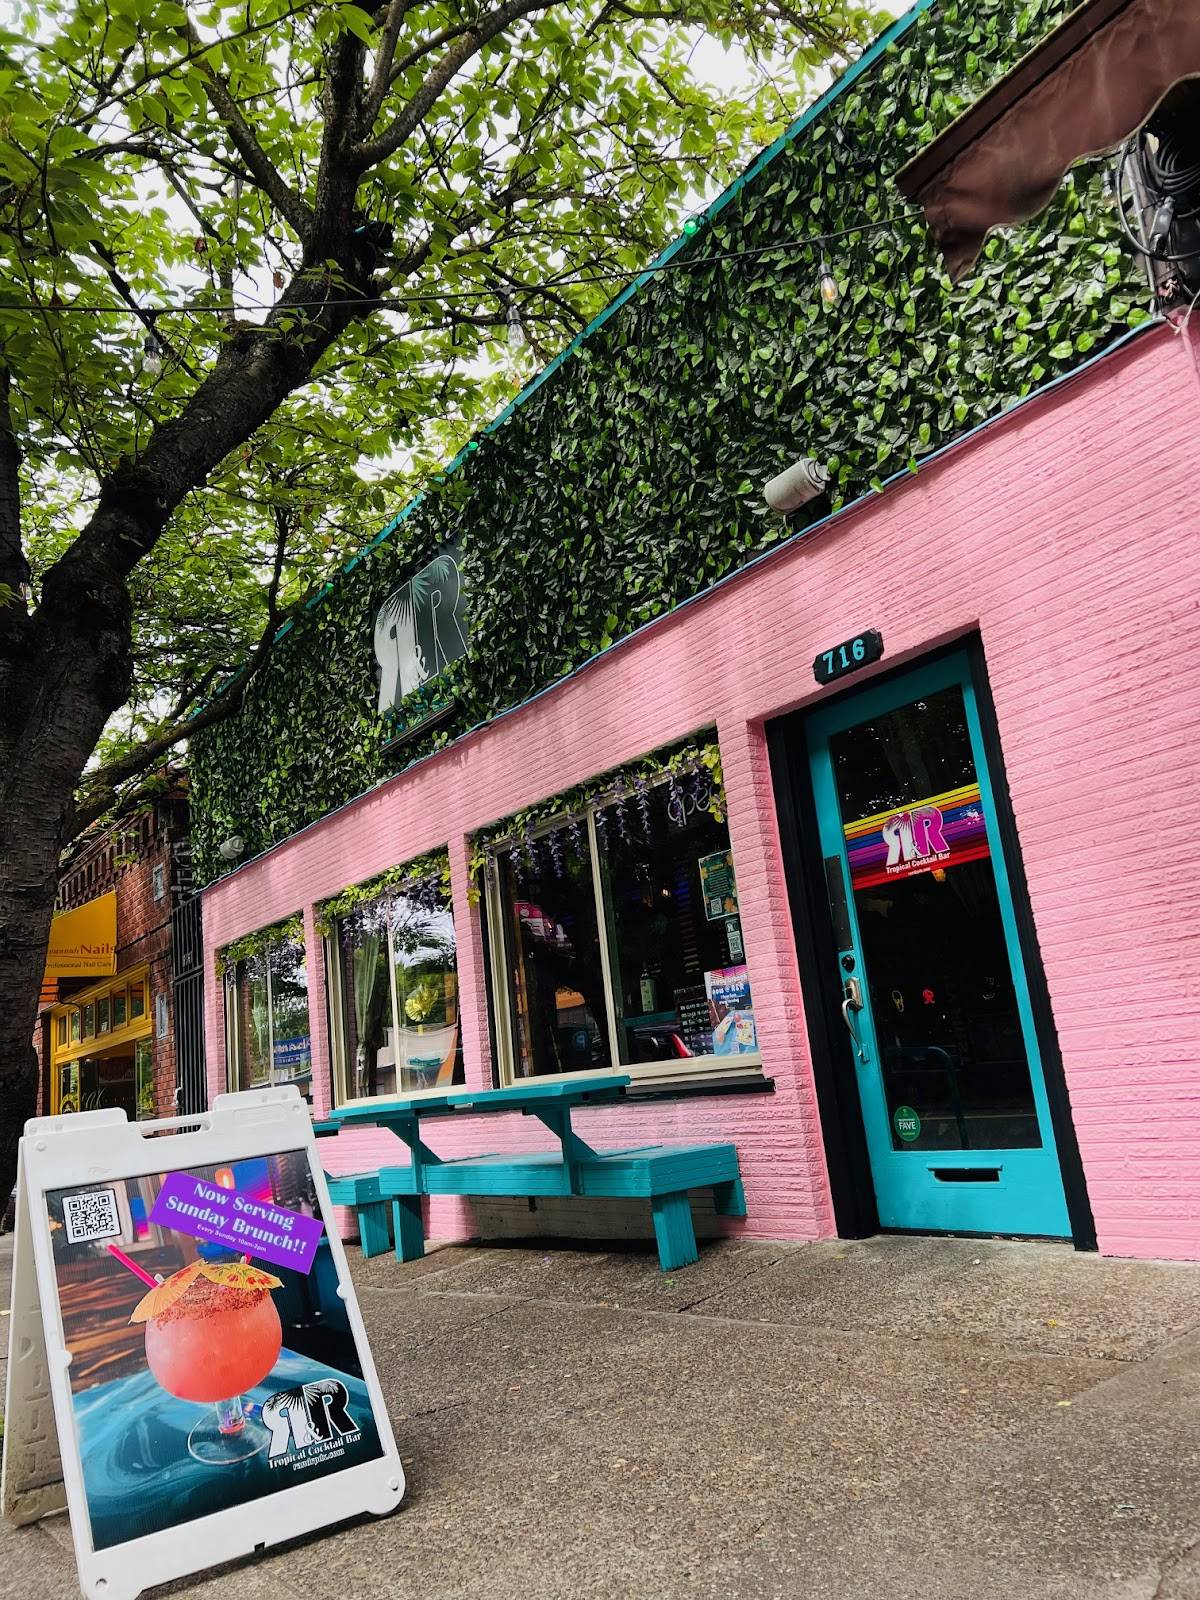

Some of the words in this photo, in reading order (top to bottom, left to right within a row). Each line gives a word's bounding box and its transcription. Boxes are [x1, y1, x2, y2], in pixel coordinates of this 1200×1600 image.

[822, 638, 865, 675] 716
[885, 861, 912, 875] Tropical
[911, 854, 938, 868] Cocktail
[938, 852, 951, 861] Bar
[899, 1121, 916, 1130] FAVE
[165, 1194, 230, 1230] Sunday
[232, 1217, 308, 1255] Brunch!!
[193, 1182, 230, 1206] Now
[232, 1195, 296, 1232] Serving
[196, 1223, 215, 1236] Every
[214, 1230, 238, 1243] Sunday
[267, 1449, 307, 1470] Tropical
[308, 1435, 344, 1457] Cocktail
[345, 1432, 362, 1445] Bar
